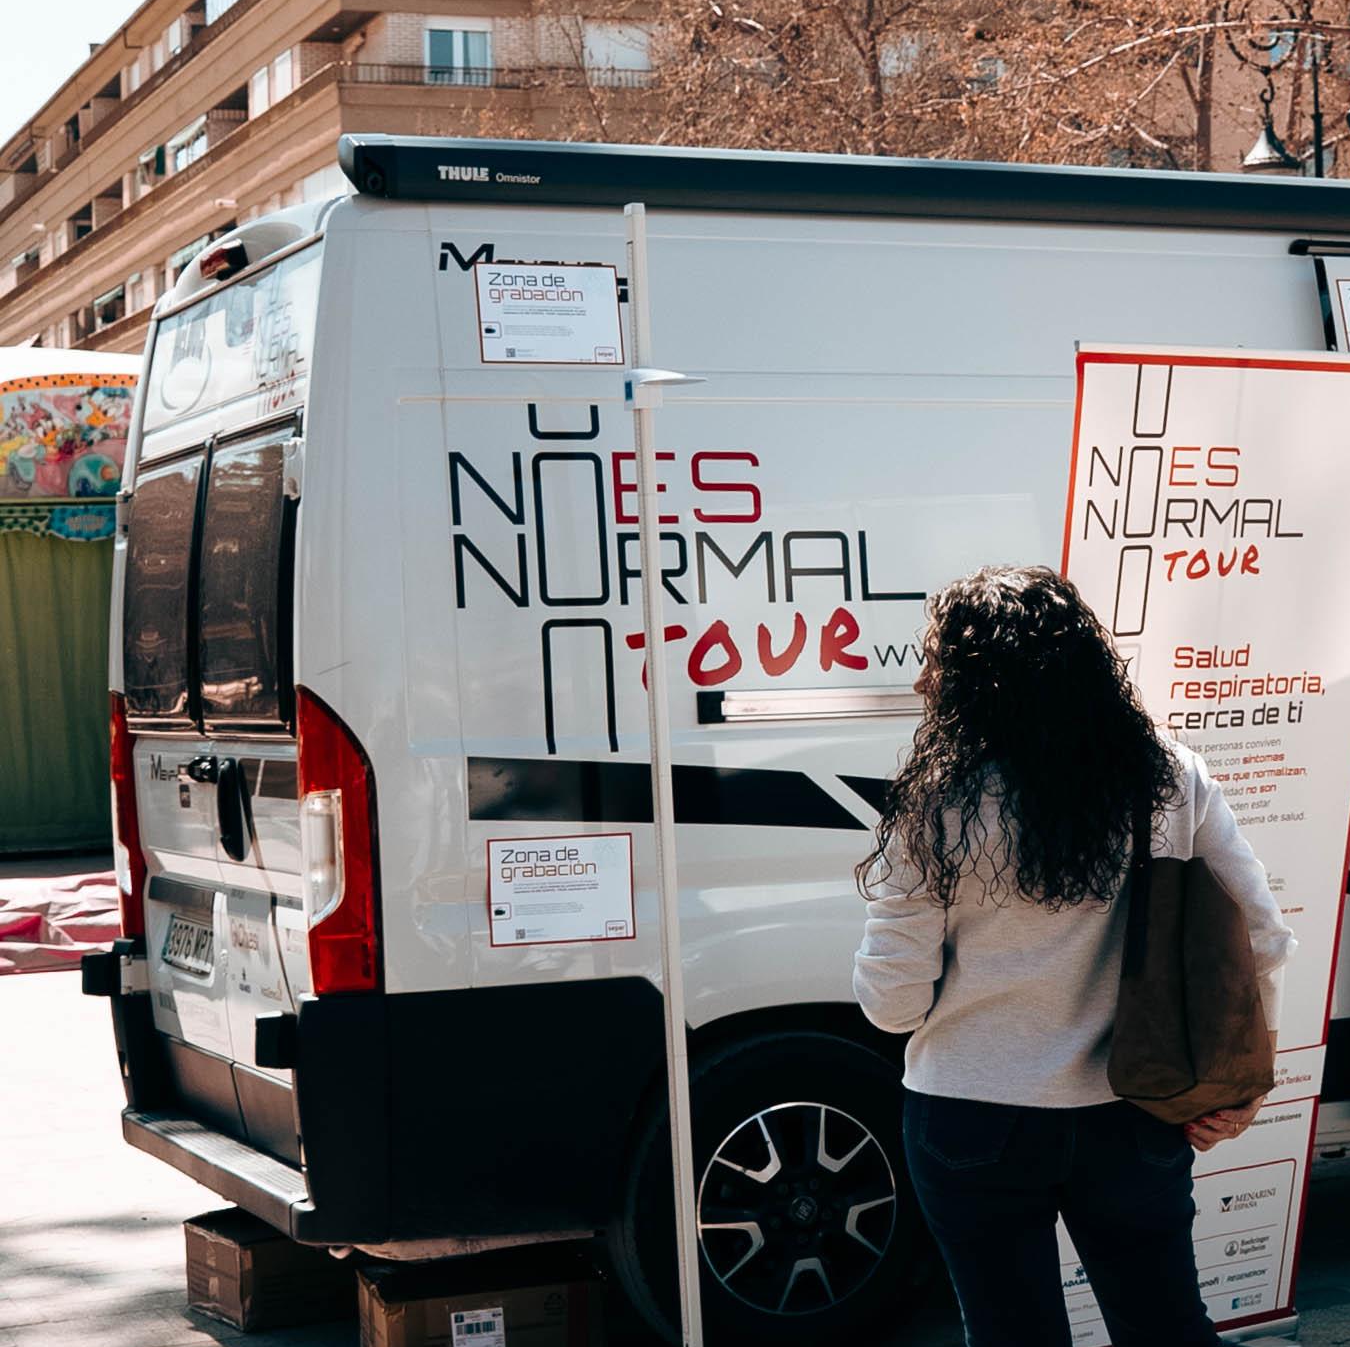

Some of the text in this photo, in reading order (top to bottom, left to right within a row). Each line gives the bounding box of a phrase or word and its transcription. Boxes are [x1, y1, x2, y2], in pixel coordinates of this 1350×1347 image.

[437, 165, 541, 185] THULE Omnistor
[488, 272, 565, 288] Zona de
[488, 286, 584, 304] grabación
[1169, 446, 1241, 487] ES
[612, 451, 762, 525] ES
[1084, 498, 1304, 540] NORMAL
[453, 530, 927, 609] NORMAL
[1163, 544, 1260, 582] TOUR
[626, 607, 869, 692] TOUR
[1174, 644, 1251, 669] Salud
[1170, 671, 1325, 705] respiratoria,
[1167, 701, 1304, 730] cerca de ti
[1204, 741, 1244, 753] personas
[1245, 736, 1282, 749] conviven
[1224, 756, 1241, 766] con
[1232, 771, 1251, 782] que
[1246, 785, 1257, 794] no
[1259, 783, 1277, 793] son
[1251, 798, 1271, 809] estar
[1267, 812, 1279, 823] de
[501, 846, 579, 864] Zona de
[501, 860, 597, 883] grabación
[1235, 1187, 1277, 1203] MENARINI
[1200, 1276, 1220, 1289] anofi
